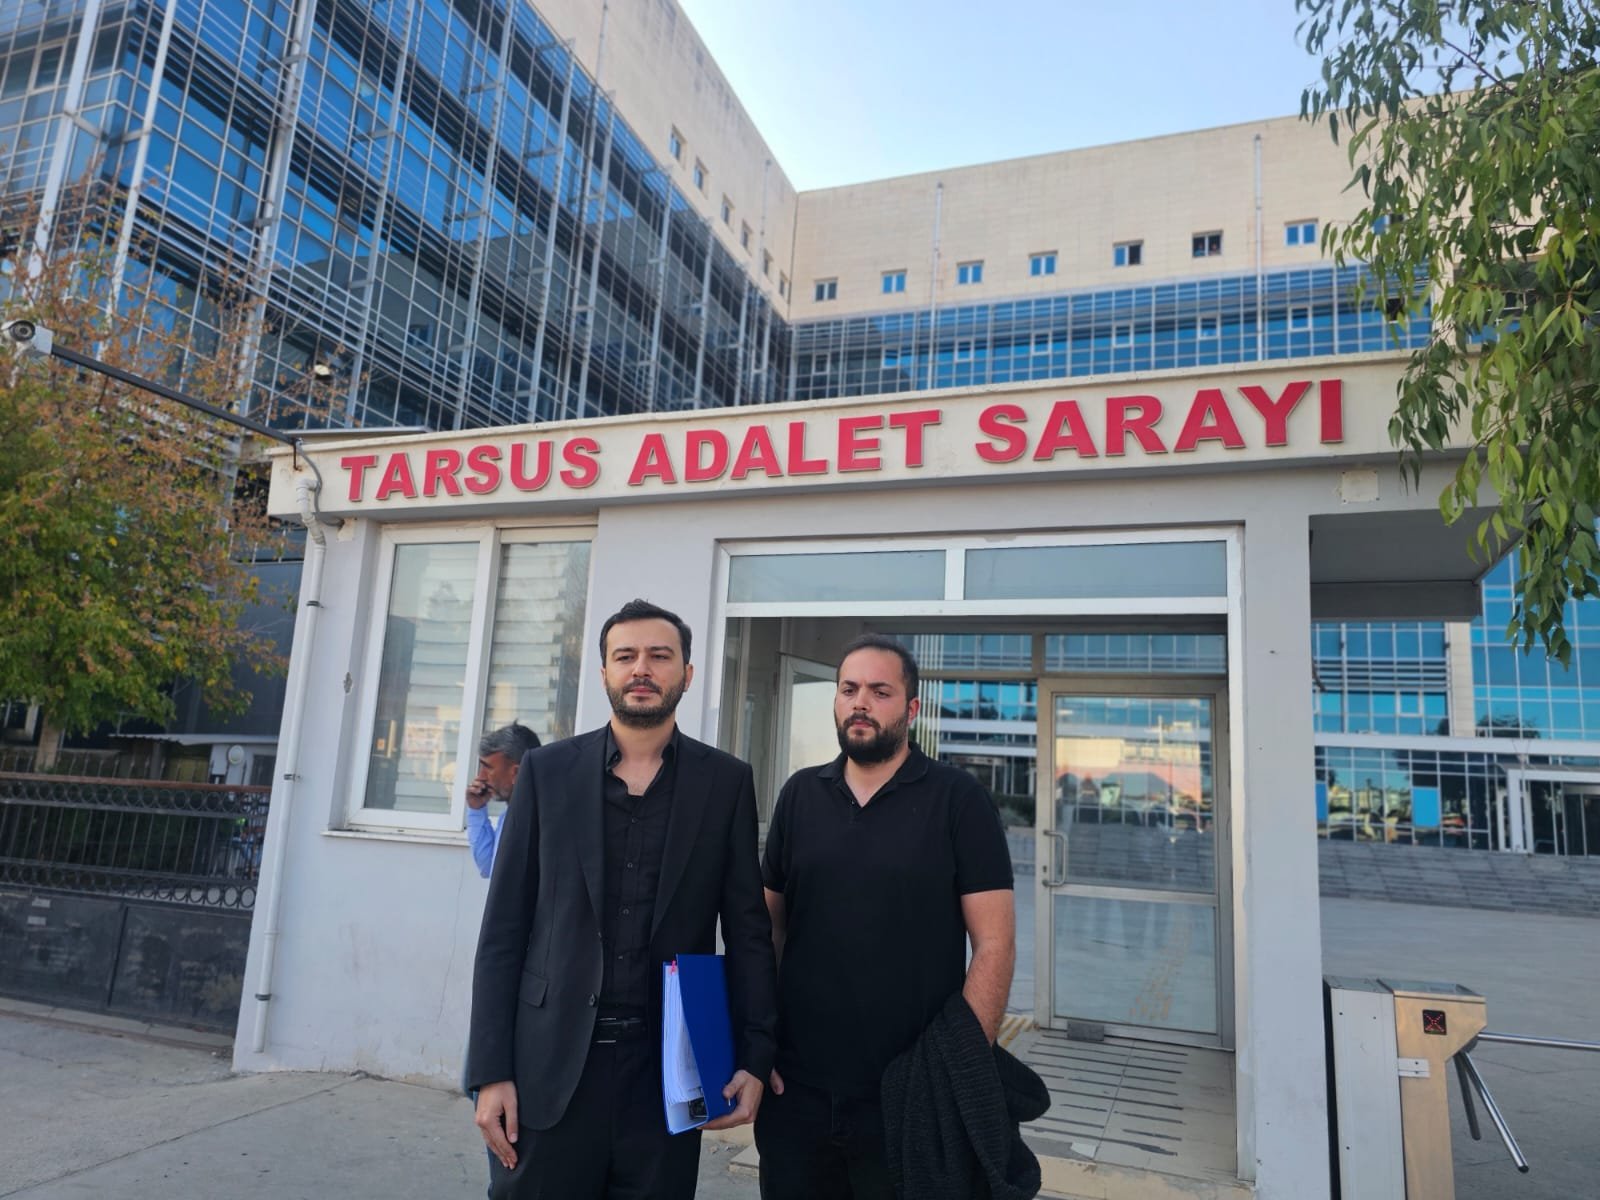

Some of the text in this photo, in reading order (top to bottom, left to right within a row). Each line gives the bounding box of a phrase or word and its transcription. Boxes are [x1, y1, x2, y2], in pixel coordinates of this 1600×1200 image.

[342, 379, 1344, 502] TARSUS ADALET SARAYI
